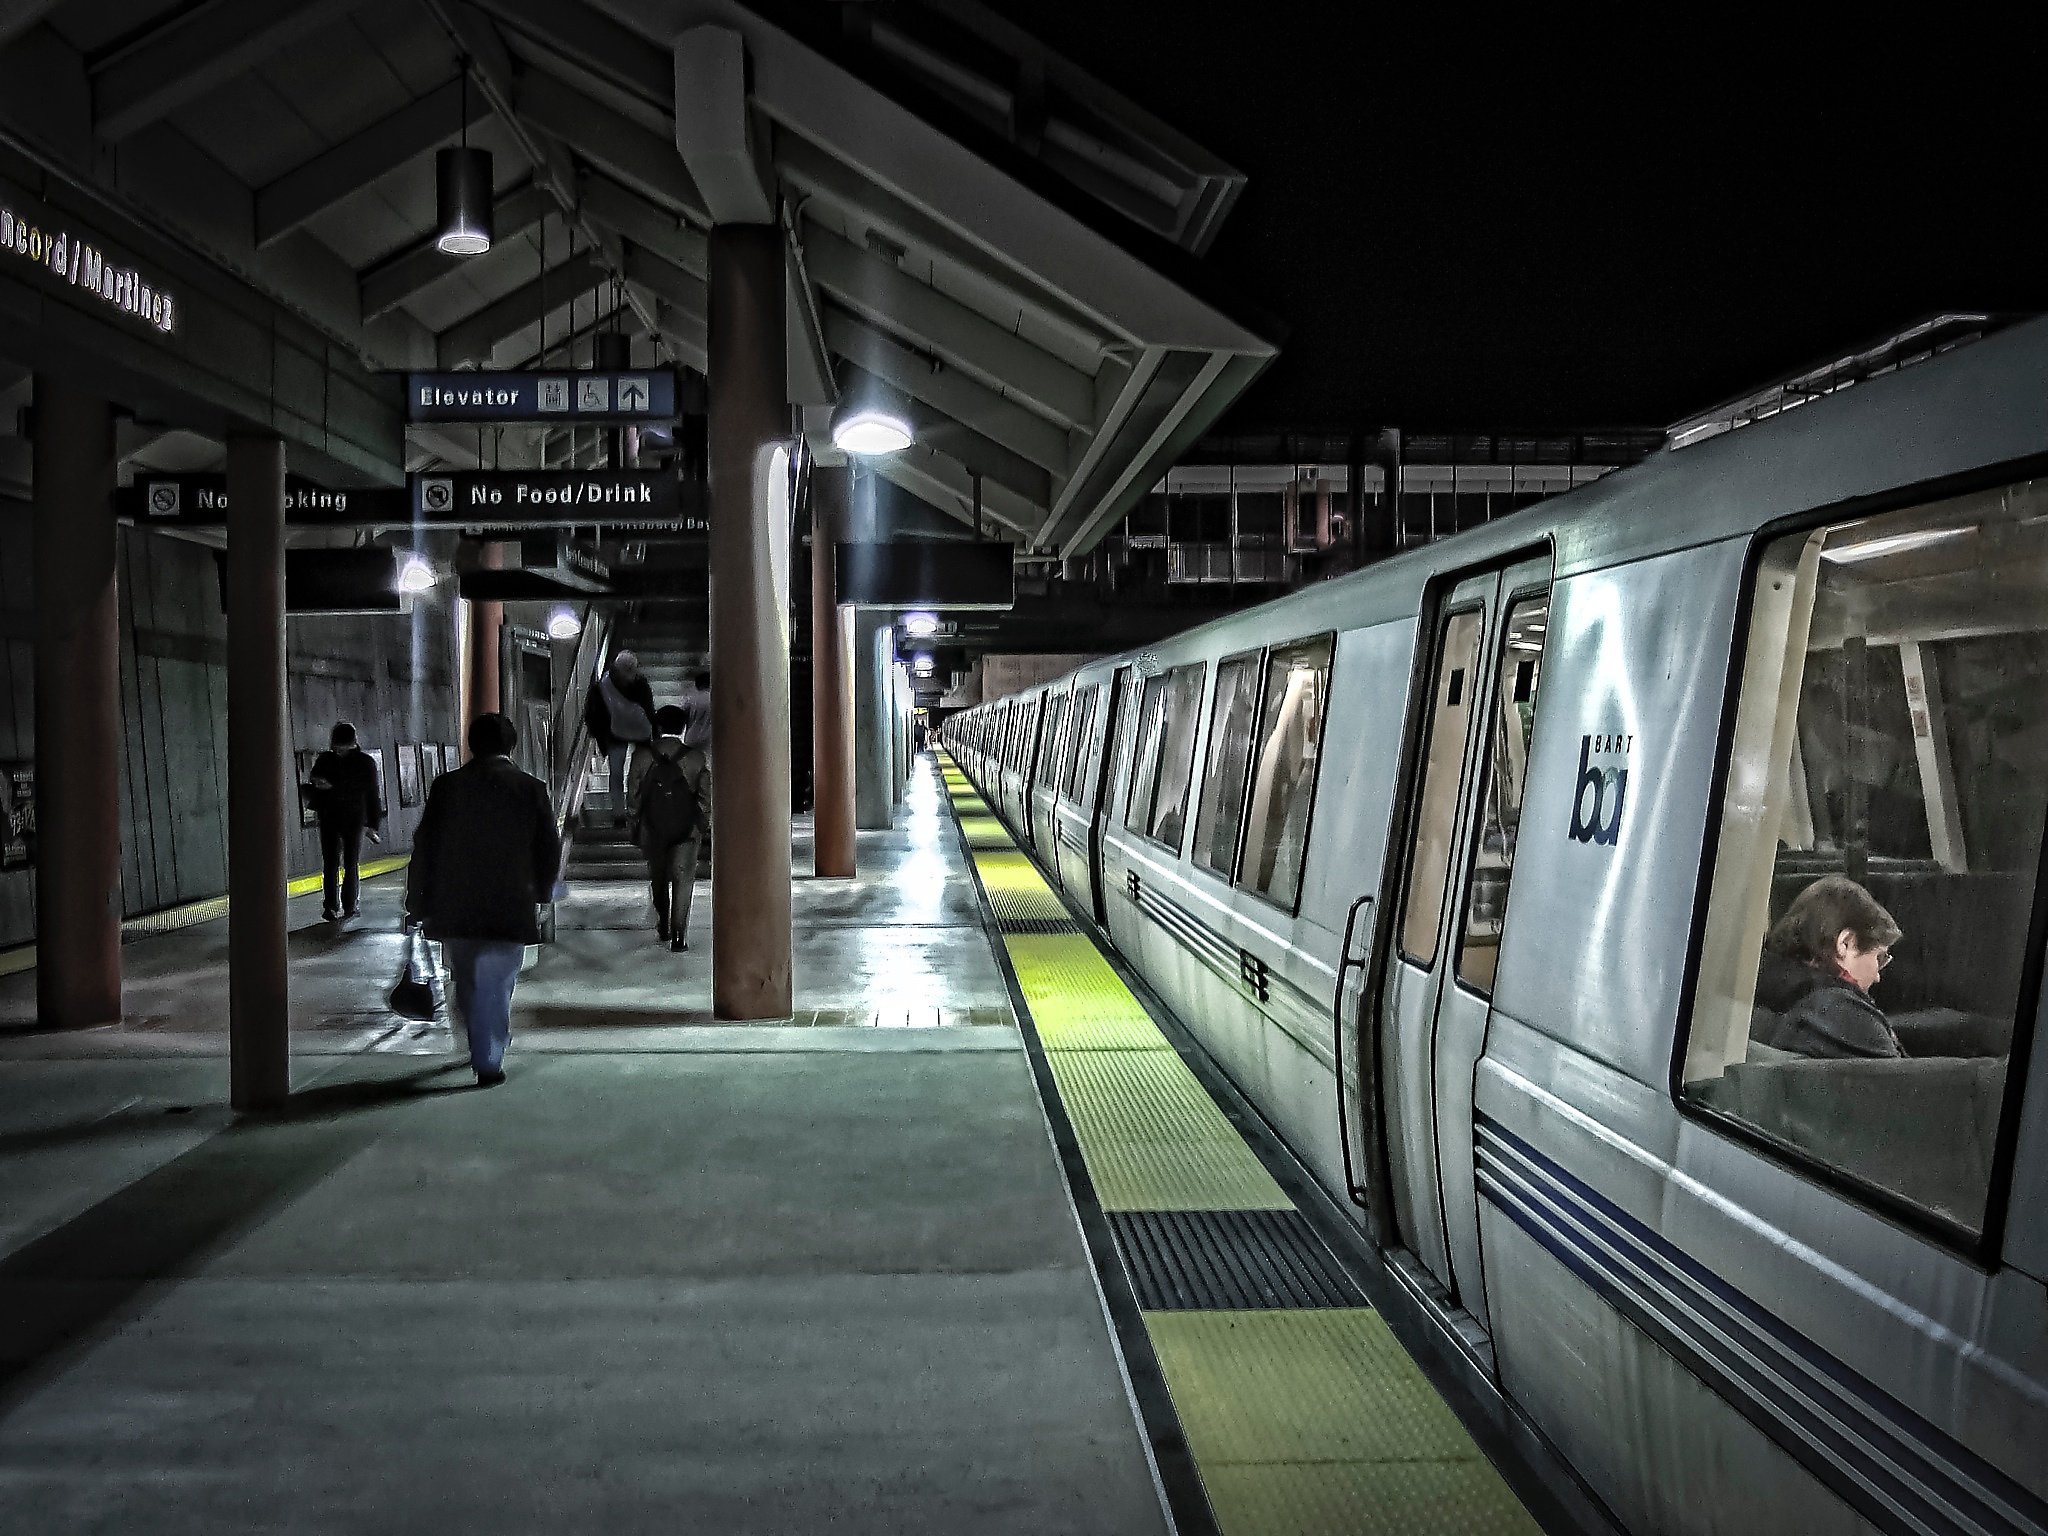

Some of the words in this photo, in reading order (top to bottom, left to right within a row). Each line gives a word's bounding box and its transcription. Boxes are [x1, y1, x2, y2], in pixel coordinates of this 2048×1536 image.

[420, 386, 519, 406] Elevator
[198, 488, 228, 508] No
[284, 489, 347, 512] oking
[471, 484, 503, 505] No
[516, 481, 651, 505] Food/Drink
[1594, 734, 1634, 754] BART
